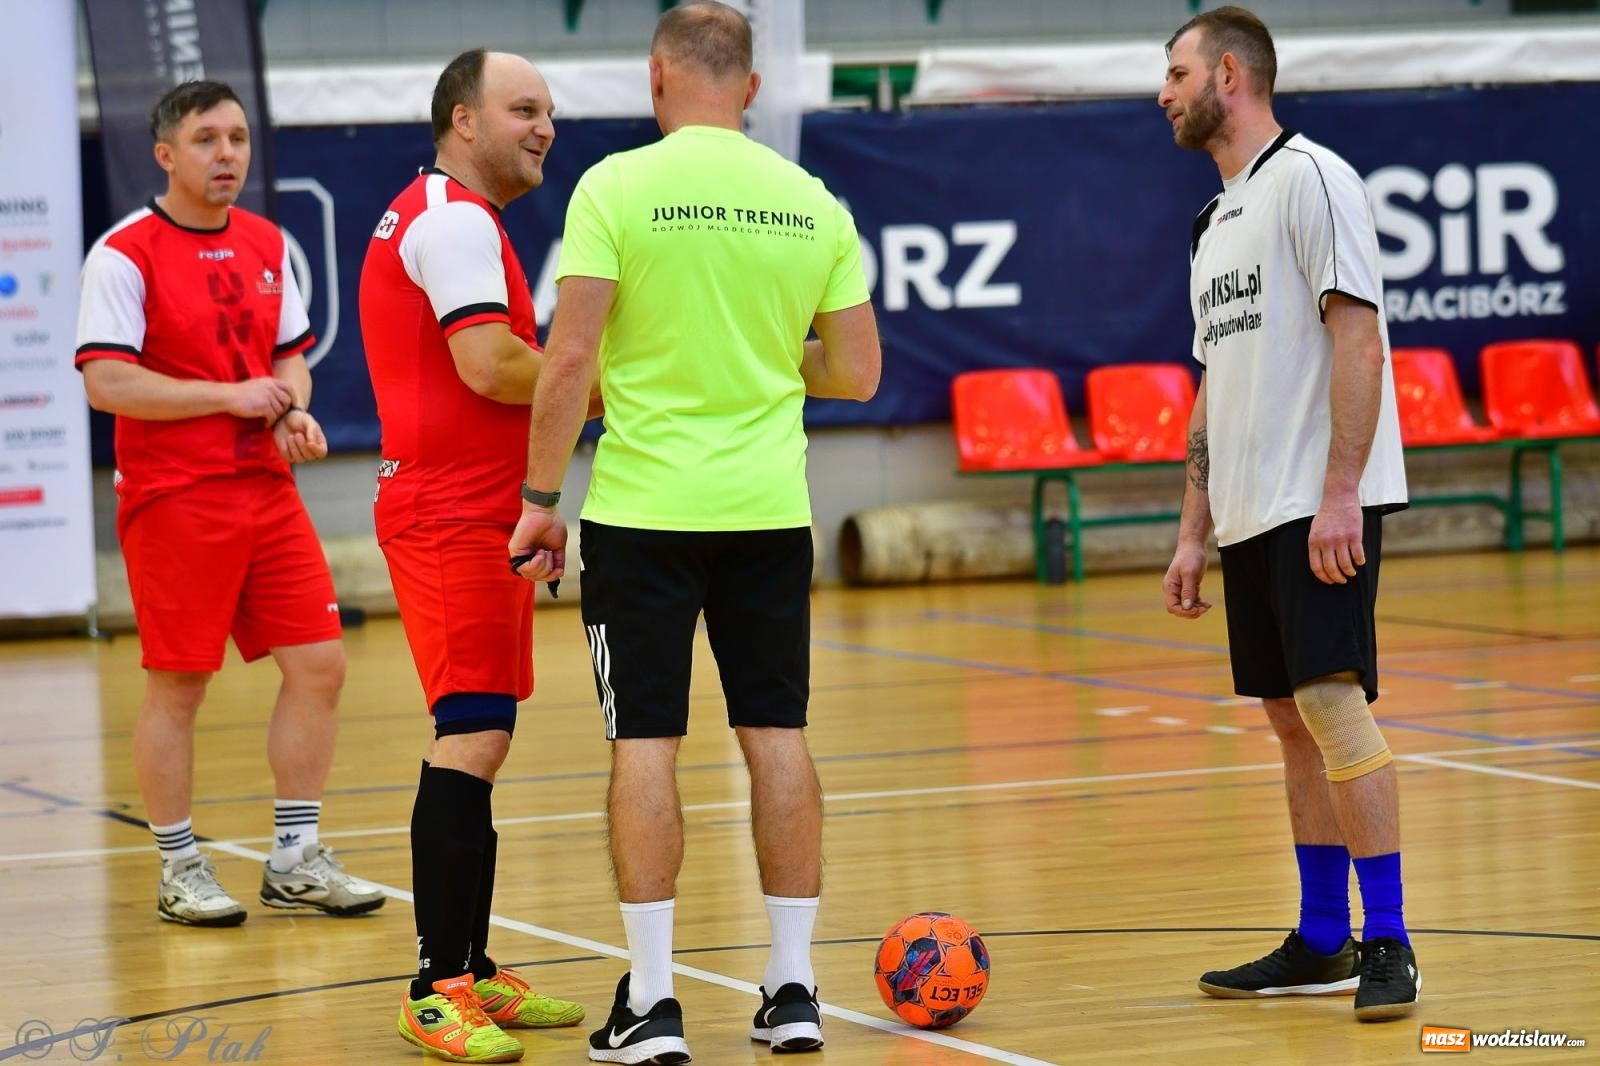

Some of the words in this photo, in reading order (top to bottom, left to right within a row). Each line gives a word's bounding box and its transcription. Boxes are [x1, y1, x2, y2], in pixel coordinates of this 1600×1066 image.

[652, 205, 727, 222] JUNIOR
[733, 208, 815, 231] TRENING
[1384, 275, 1566, 323] RACIBÓRZ
[929, 982, 984, 1002] SELECT
